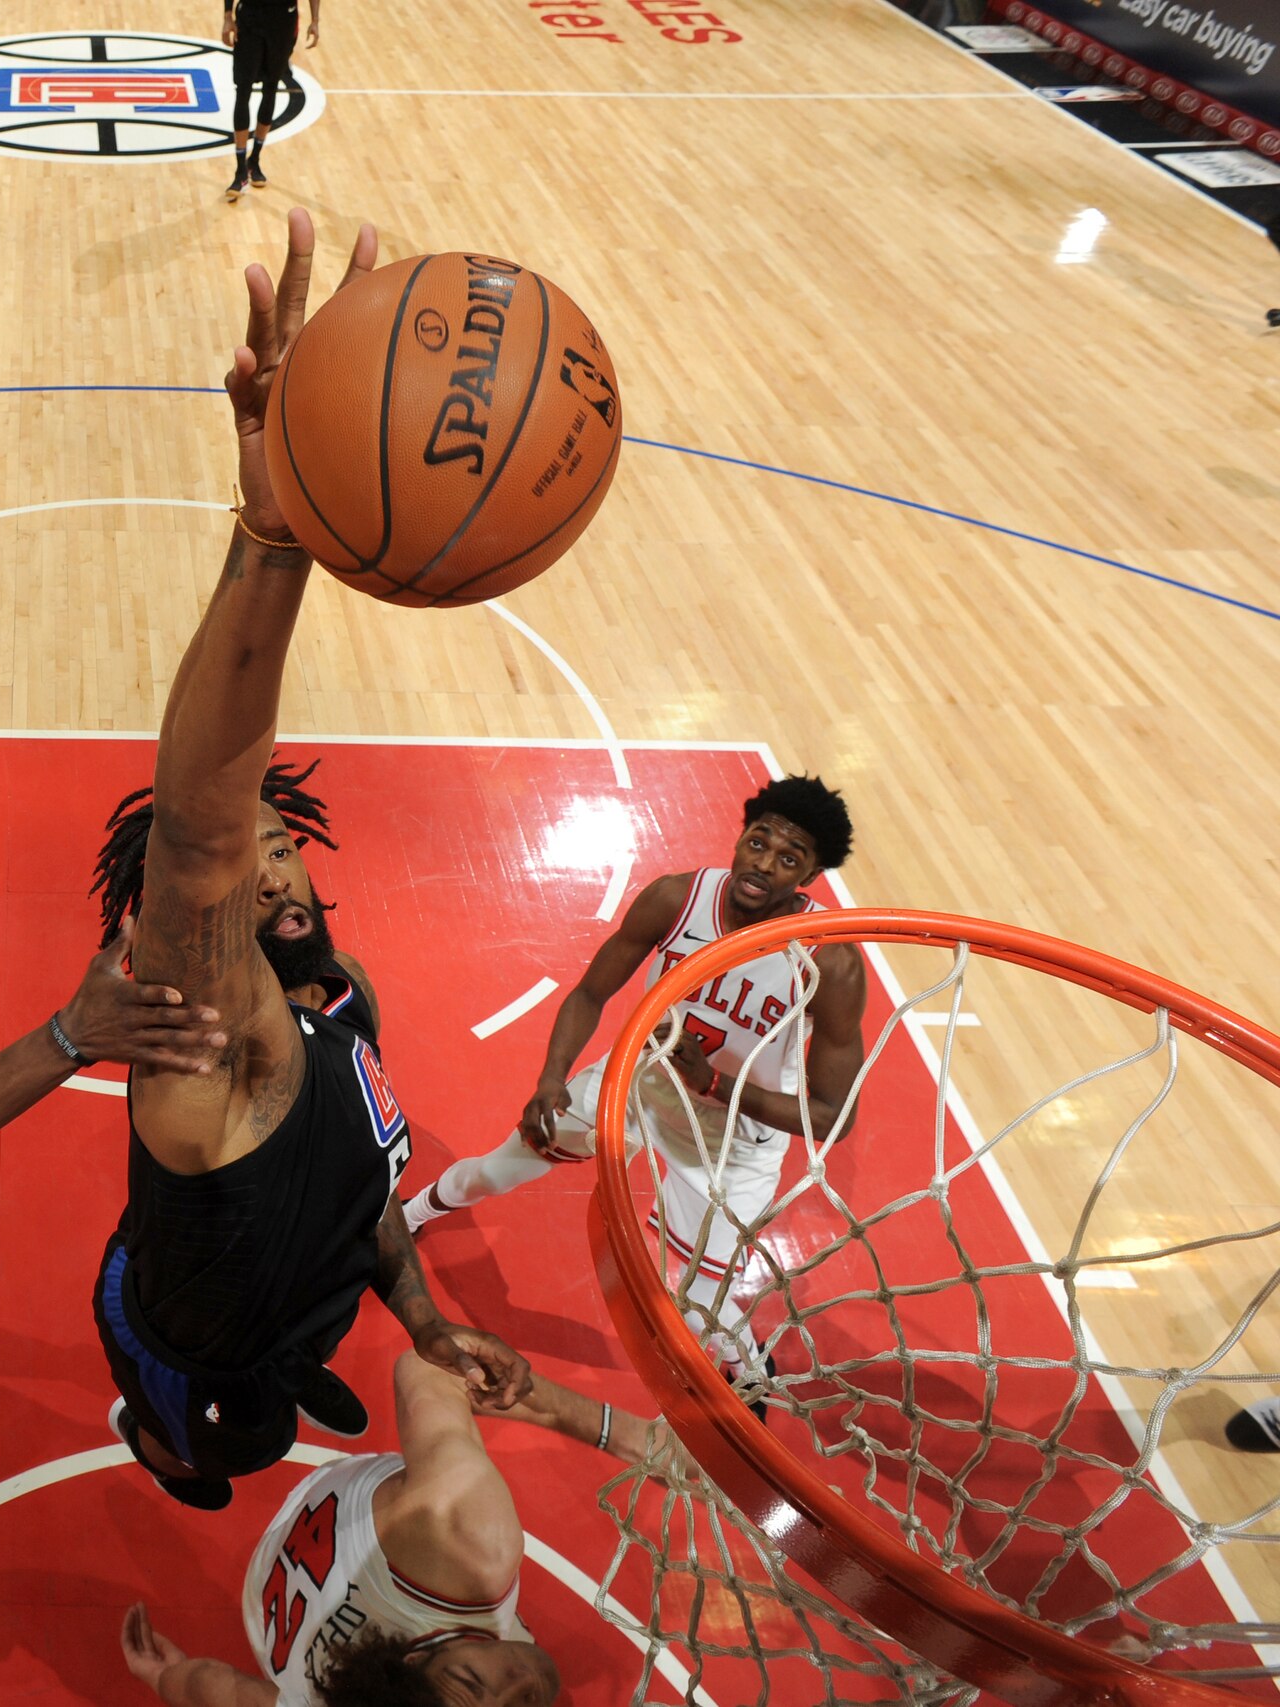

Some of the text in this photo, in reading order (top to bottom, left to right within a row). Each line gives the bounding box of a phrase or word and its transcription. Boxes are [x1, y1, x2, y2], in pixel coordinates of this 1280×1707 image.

[1162, 4, 1201, 36] car
[1193, 9, 1277, 76] buying
[423, 255, 522, 475] SPALDING
[531, 409, 587, 497] OFFICIAL GAME BALL
[660, 950, 787, 1044] LLS
[261, 1490, 340, 1676] 42
